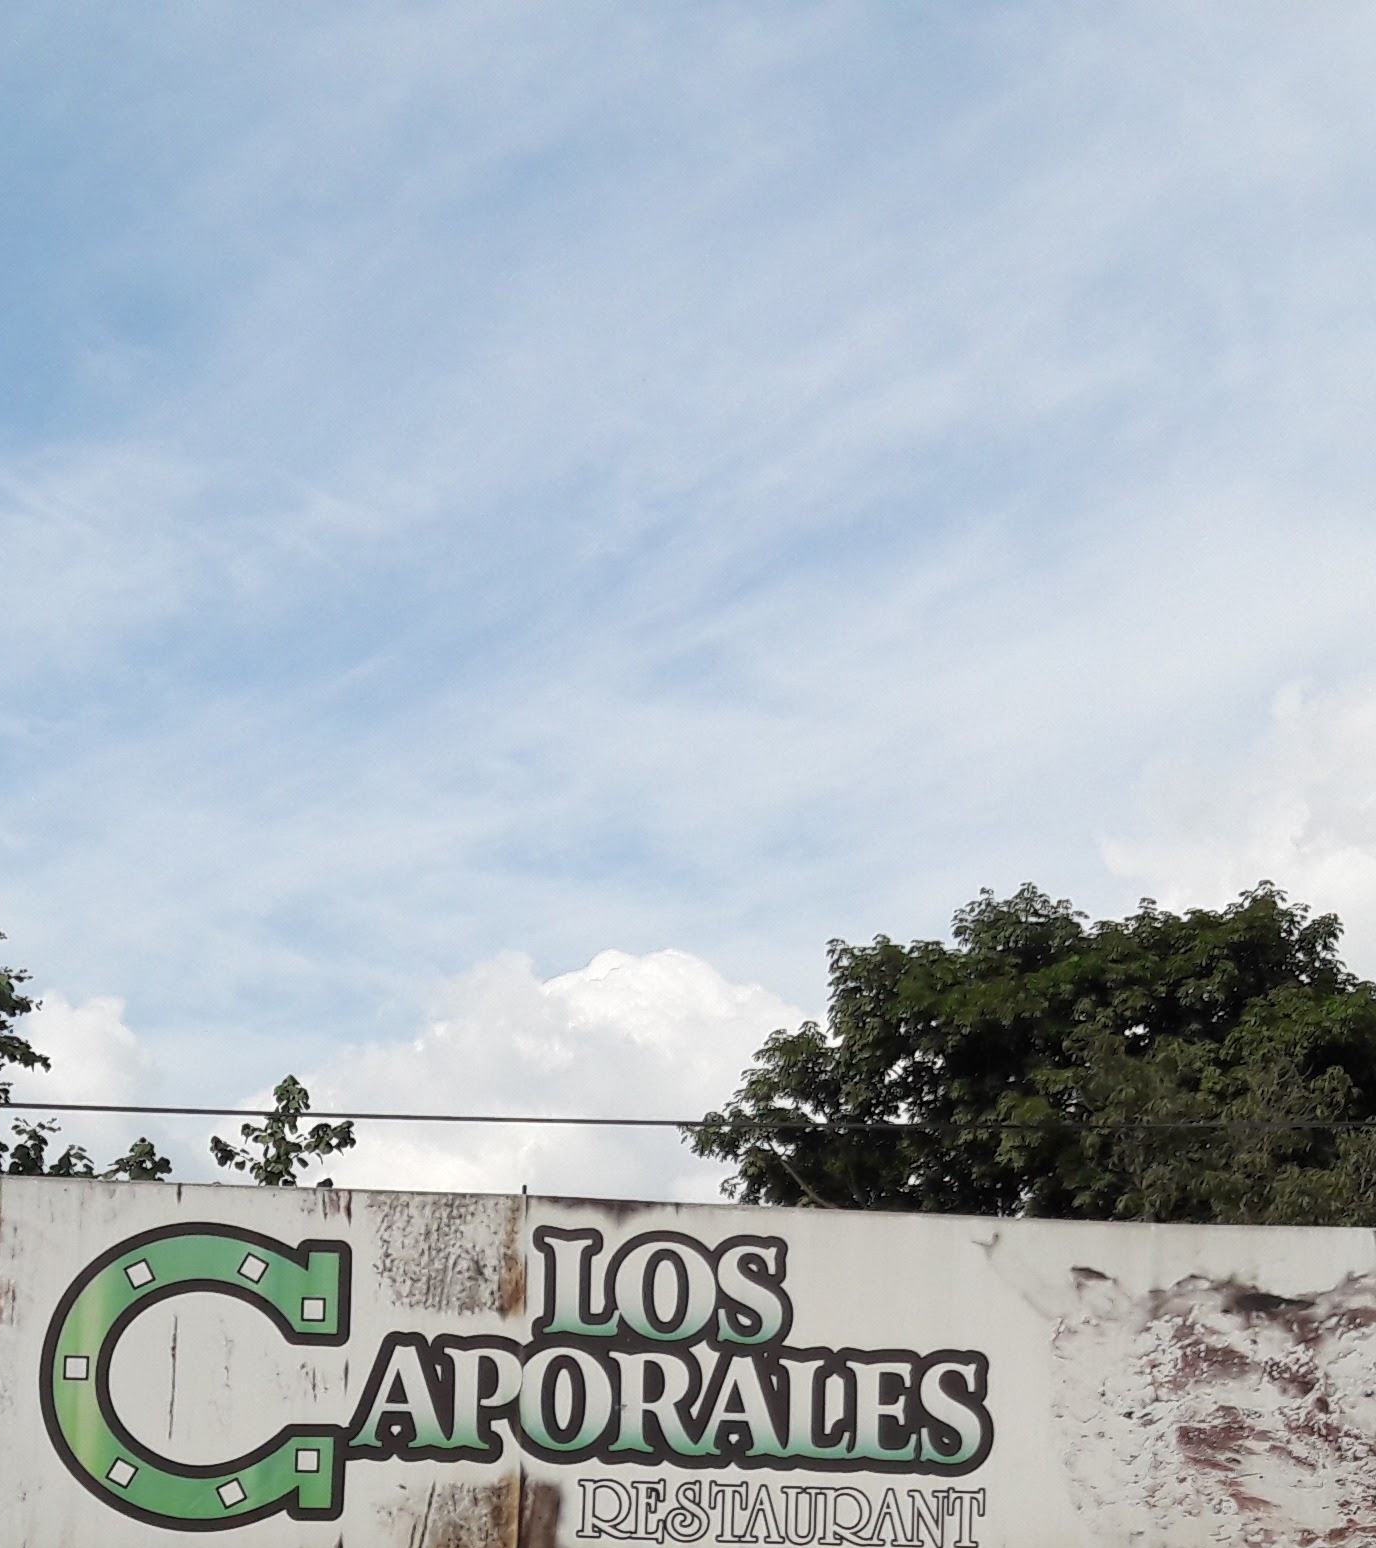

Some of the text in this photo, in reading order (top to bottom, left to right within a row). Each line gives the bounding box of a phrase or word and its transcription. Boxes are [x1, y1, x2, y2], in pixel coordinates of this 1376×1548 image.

[533, 1226, 791, 1344] LOS
[40, 1222, 994, 1532] CAPORALES
[576, 1478, 986, 1548] RESTAURANT
